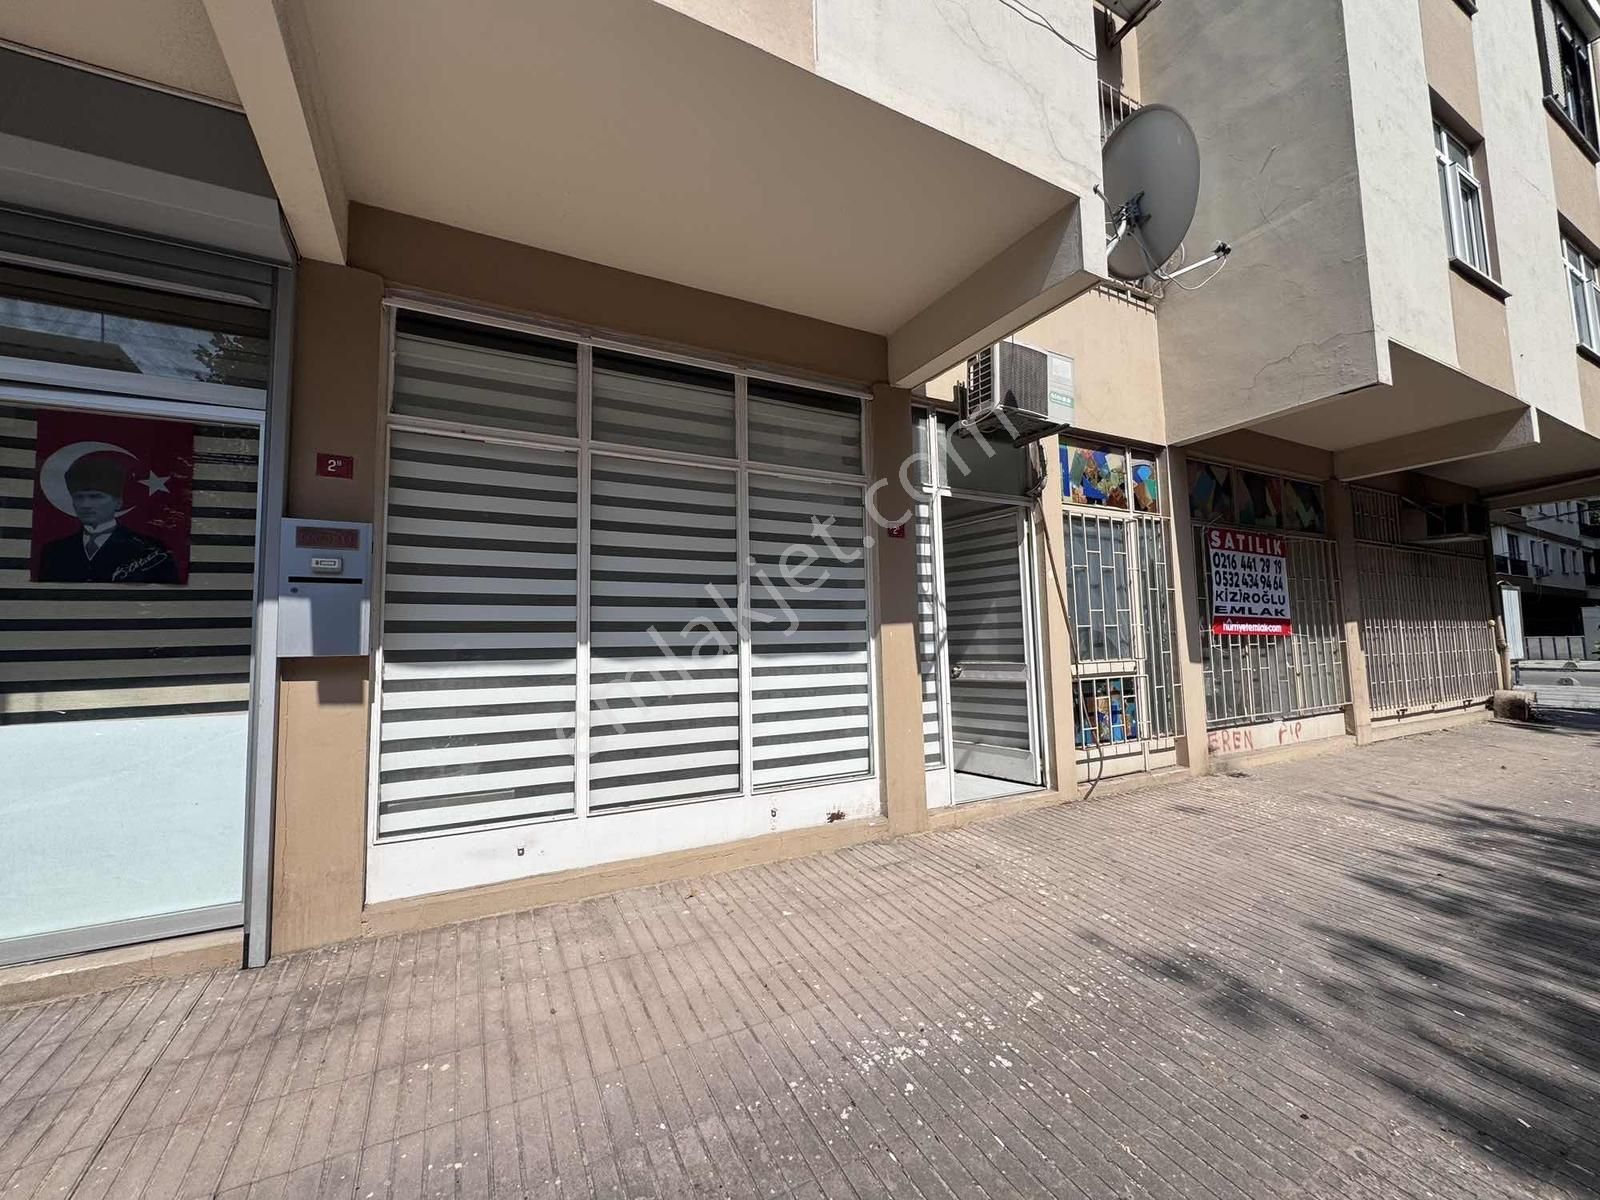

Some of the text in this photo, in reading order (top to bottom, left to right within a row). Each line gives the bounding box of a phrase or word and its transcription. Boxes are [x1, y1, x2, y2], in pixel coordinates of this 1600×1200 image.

[1210, 529, 1282, 556] SATILIK
[1213, 551, 1237, 570] 0216
[1240, 555, 1257, 573] 441
[1273, 559, 1282, 575] 19
[1214, 570, 1284, 592] 0532 434 94 64
[1215, 588, 1286, 606] KİZİROĞLU
[1214, 605, 1286, 617] EMLAK
[1208, 729, 1254, 753] EREN
